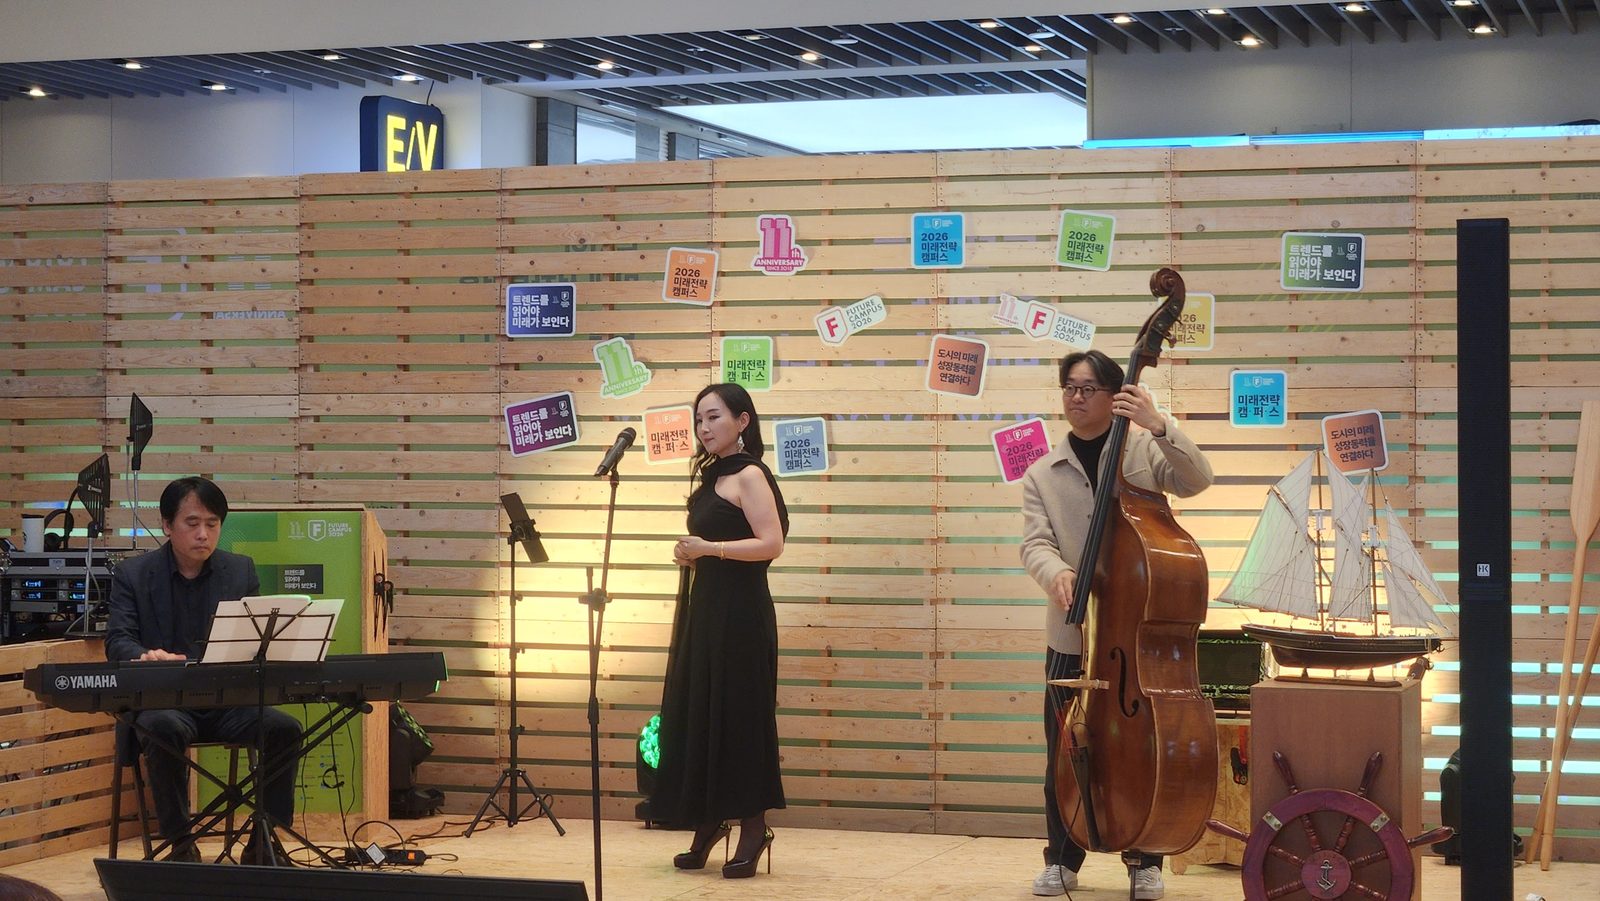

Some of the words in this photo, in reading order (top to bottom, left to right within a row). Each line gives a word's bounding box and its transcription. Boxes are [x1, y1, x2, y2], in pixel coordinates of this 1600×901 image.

[387, 114, 438, 172] E/V
[921, 232, 949, 241] 2026
[1068, 230, 1096, 242] 2026
[921, 241, 958, 252] 미래전략
[1067, 240, 1104, 254] 미래전략
[1288, 244, 1333, 258] 트렌드를
[756, 258, 804, 266] ANNIVERSARY
[922, 252, 949, 263] 캠퍼스
[1066, 250, 1093, 263] 캠퍼스
[1288, 256, 1322, 269] 읽어야
[674, 268, 700, 278] 2026
[1288, 268, 1322, 280] 미래가
[1322, 269, 1356, 282] 보인다
[674, 277, 708, 289] 미래전략
[672, 286, 698, 298] 캠퍼스
[512, 294, 550, 306] 트렌드를
[846, 298, 875, 316] FUTURE
[512, 305, 540, 317] 읽어야
[848, 304, 883, 323] CAMPUS
[512, 316, 540, 328] 미래가
[541, 316, 570, 328] 보인다
[825, 316, 839, 338] F
[852, 316, 872, 330] 2026
[1031, 310, 1047, 330] F
[1058, 316, 1088, 332] FUTURE
[1054, 331, 1075, 344] 2026
[1056, 324, 1091, 341] CAMPUS
[937, 349, 961, 361] 도시의
[962, 352, 979, 364] 미래
[728, 360, 766, 371] 미래전략
[938, 360, 976, 376] 성장동력을
[940, 372, 971, 386] 연결하다
[1238, 394, 1280, 406] 미래전략
[512, 408, 548, 426] 트렌드를
[513, 420, 542, 437] 읽어야
[516, 431, 543, 446] 미래가
[544, 424, 572, 440] 보인다
[650, 428, 688, 443] 미래전략
[1331, 427, 1356, 440] 도시의
[1357, 424, 1375, 435] 미래
[784, 438, 810, 449] 2026
[1006, 442, 1032, 456] 2026
[1334, 436, 1376, 452] 성장동력을
[784, 447, 820, 460] 미래전략
[1340, 448, 1374, 463] 연결하다
[786, 458, 812, 470] 캠퍼스
[312, 523, 322, 536] F
[70, 674, 118, 688] YAMAHA
